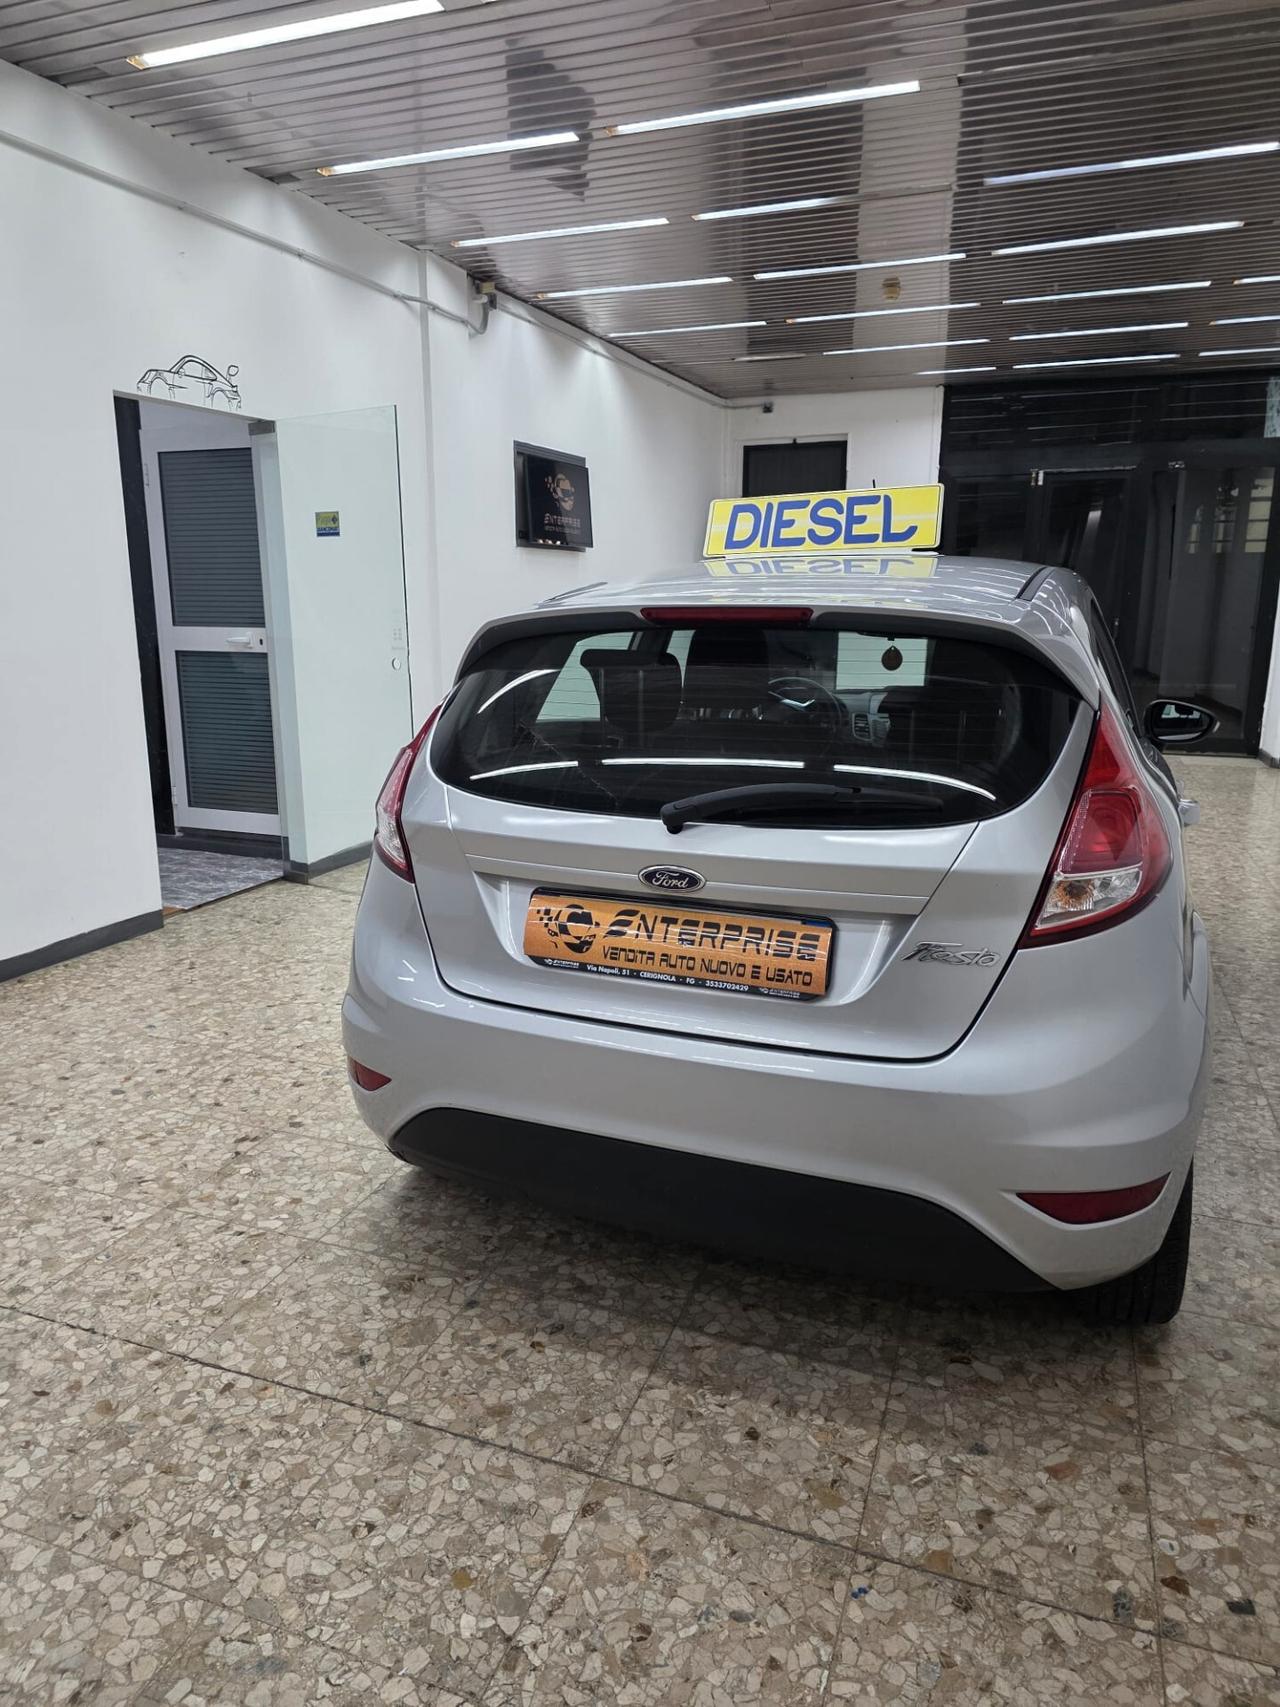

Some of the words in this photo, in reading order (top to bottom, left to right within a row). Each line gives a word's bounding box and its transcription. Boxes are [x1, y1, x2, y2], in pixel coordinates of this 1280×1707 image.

[725, 494, 918, 550] DIESEL
[652, 871, 688, 889] Ford
[603, 908, 821, 961] ENTERPRISE
[901, 941, 1000, 967] Fiesta
[586, 964, 597, 972] Via
[640, 971, 676, 982] CERIGNOLA
[660, 953, 696, 971] AUTO
[700, 959, 746, 977] NUOVO
[751, 965, 761, 979] E
[766, 967, 813, 986] USATO
